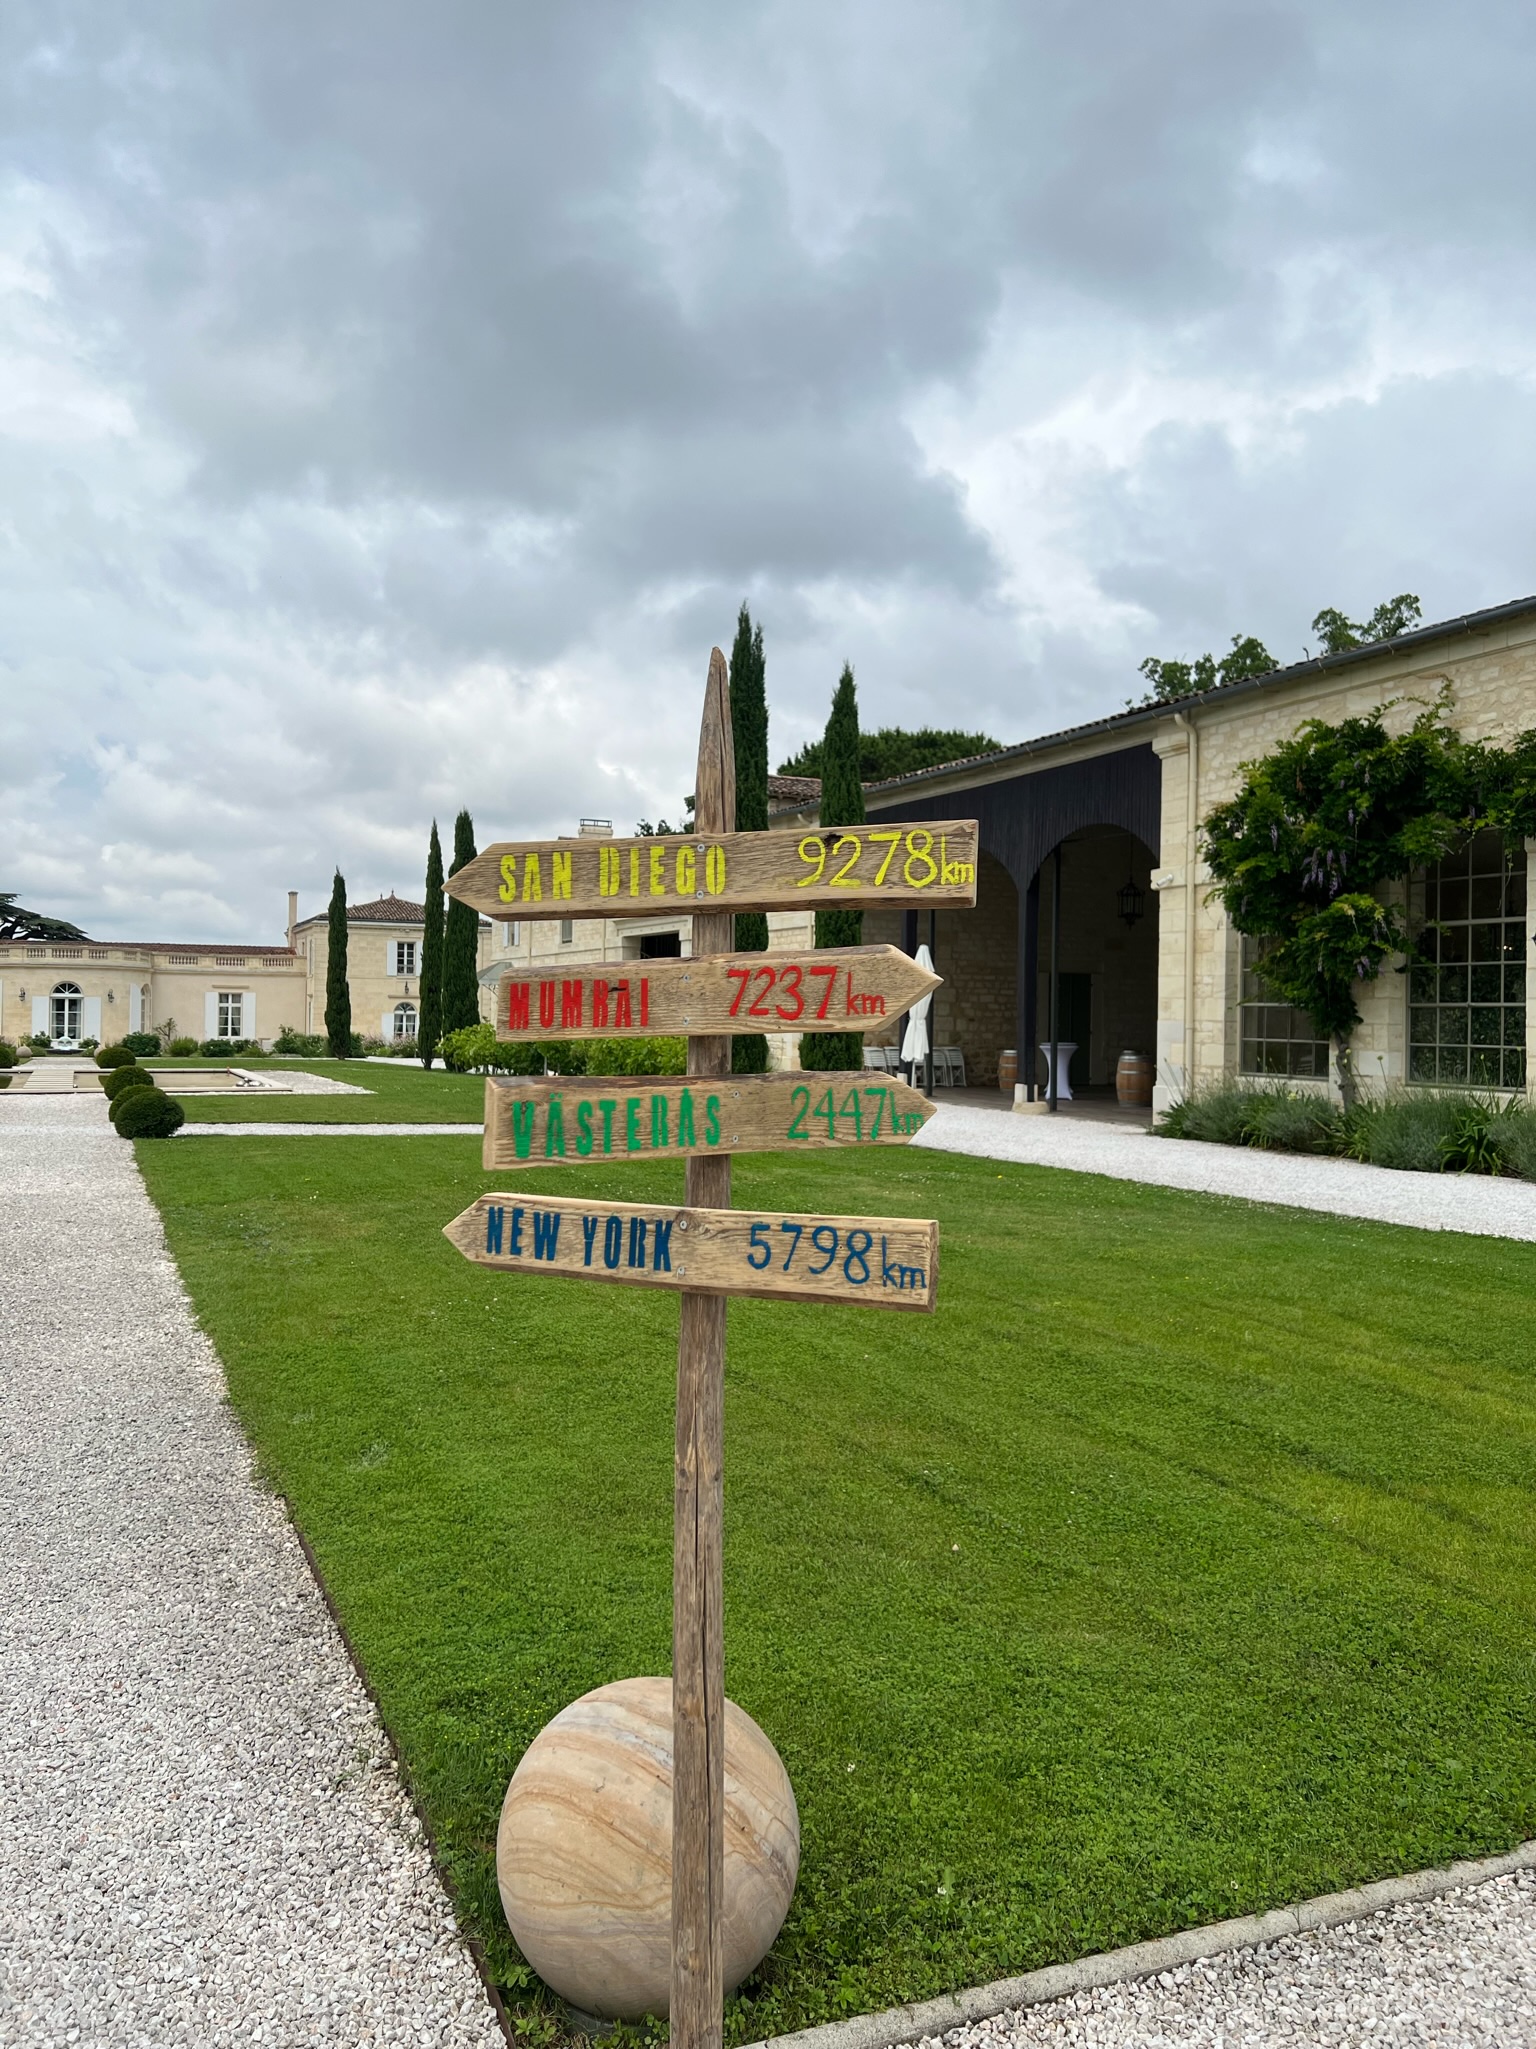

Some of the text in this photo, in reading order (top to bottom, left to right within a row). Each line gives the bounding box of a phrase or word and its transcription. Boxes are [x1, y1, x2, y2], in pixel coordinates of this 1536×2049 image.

[498, 852, 573, 903] SAN
[599, 845, 727, 897] DIEGO
[509, 978, 648, 1030] MUMBAI
[513, 1088, 720, 1158] VÄSTERÅS
[488, 1208, 560, 1260] NEW
[584, 1217, 672, 1271] YORK
